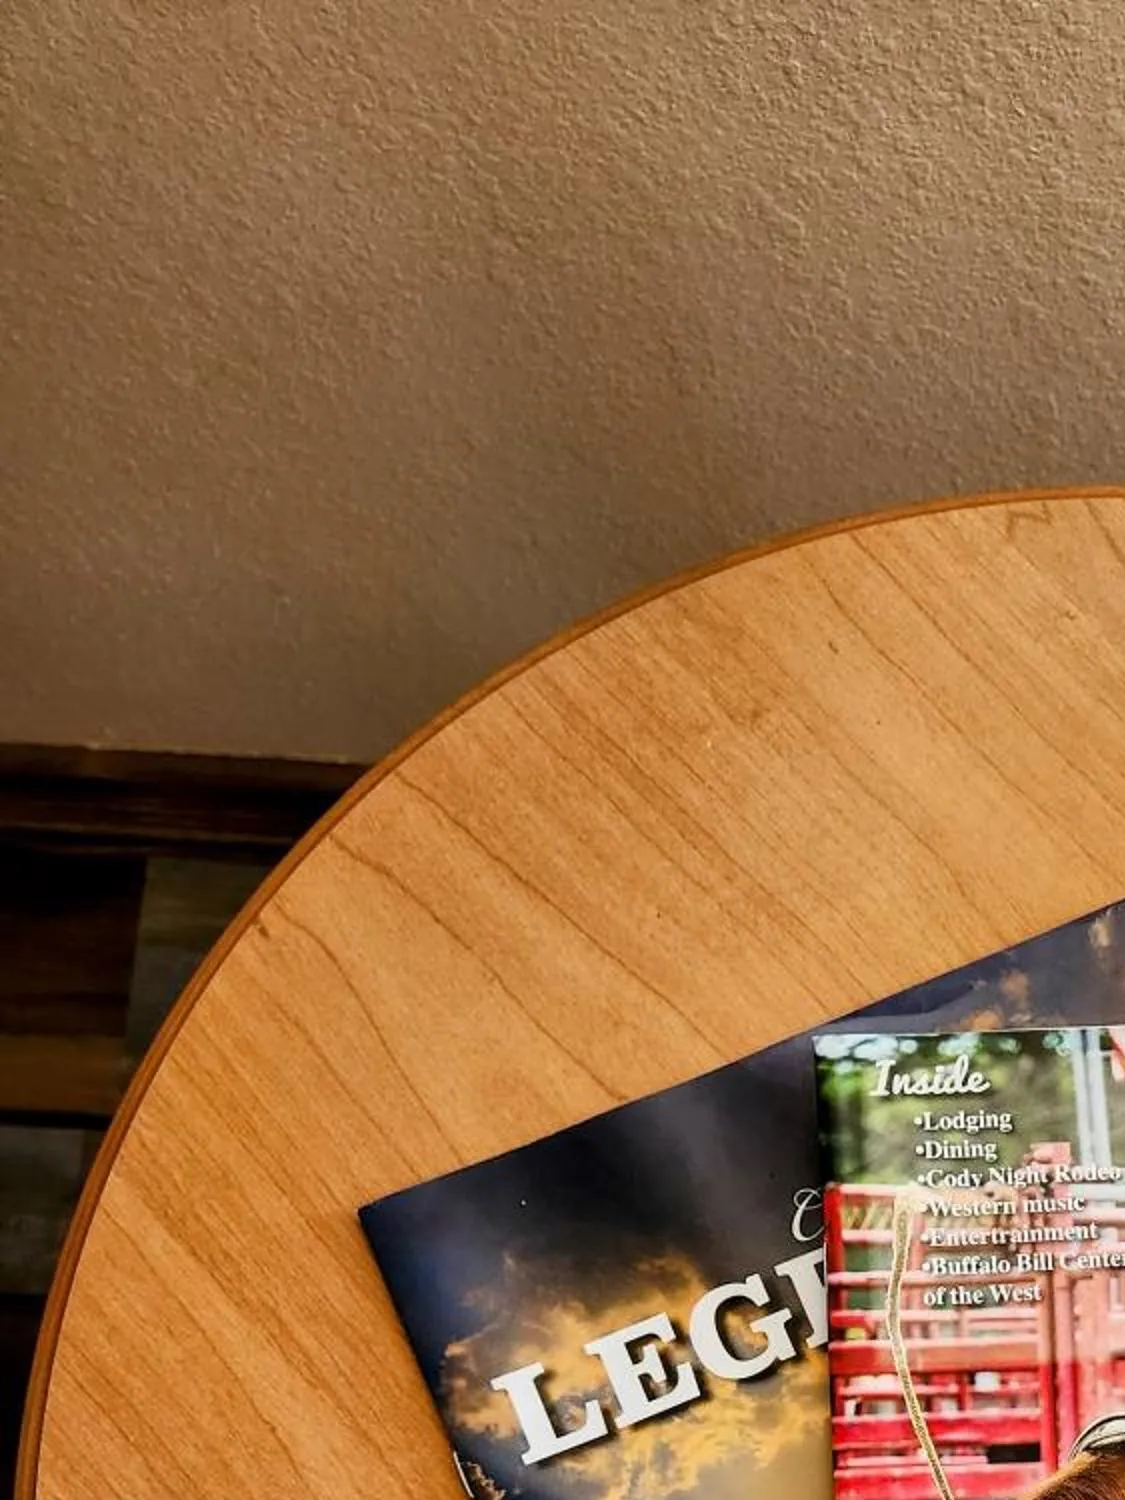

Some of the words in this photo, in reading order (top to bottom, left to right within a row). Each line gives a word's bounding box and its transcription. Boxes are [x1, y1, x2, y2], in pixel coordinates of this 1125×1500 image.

[869, 1054, 991, 1097] Inside
[989, 1166, 1048, 1188] Night
[1055, 1163, 1122, 1183] Rodeo
[1023, 1193, 1086, 1213] music
[1017, 1251, 1054, 1272] Bill
[924, 1287, 946, 1306] of
[949, 1285, 984, 1306] the
[989, 1283, 1042, 1303] West
